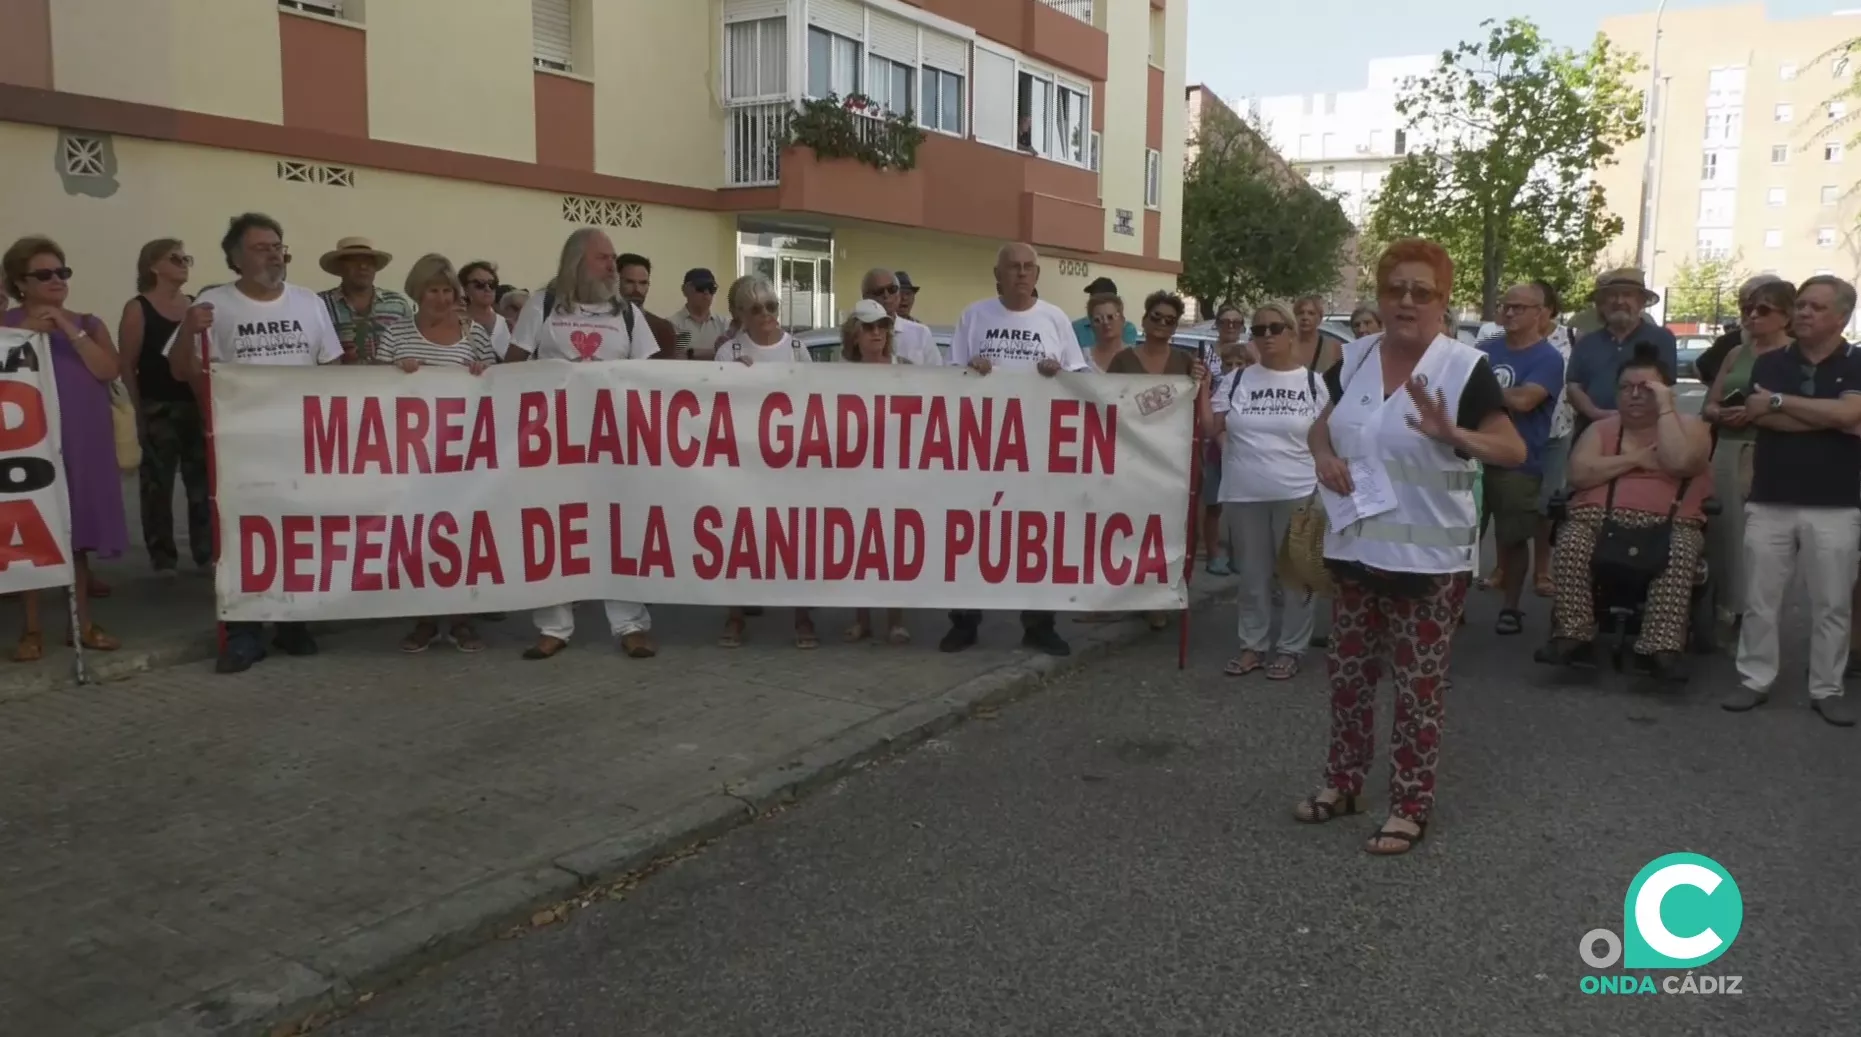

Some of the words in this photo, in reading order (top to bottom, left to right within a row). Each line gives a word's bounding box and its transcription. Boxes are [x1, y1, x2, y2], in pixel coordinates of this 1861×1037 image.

[237, 320, 303, 336] MAREA
[985, 329, 1041, 342] MAREA
[1251, 388, 1306, 401] MAREA
[302, 396, 499, 475] MAREA
[517, 388, 740, 468] BLANCA
[758, 391, 1030, 472] GADITANA
[1047, 399, 1118, 475] EN
[239, 510, 506, 593] DEFENSA
[520, 502, 591, 583] DE
[609, 502, 676, 578] LA
[692, 505, 926, 582] SANIDAD
[943, 490, 1168, 586] PÚBLICA
